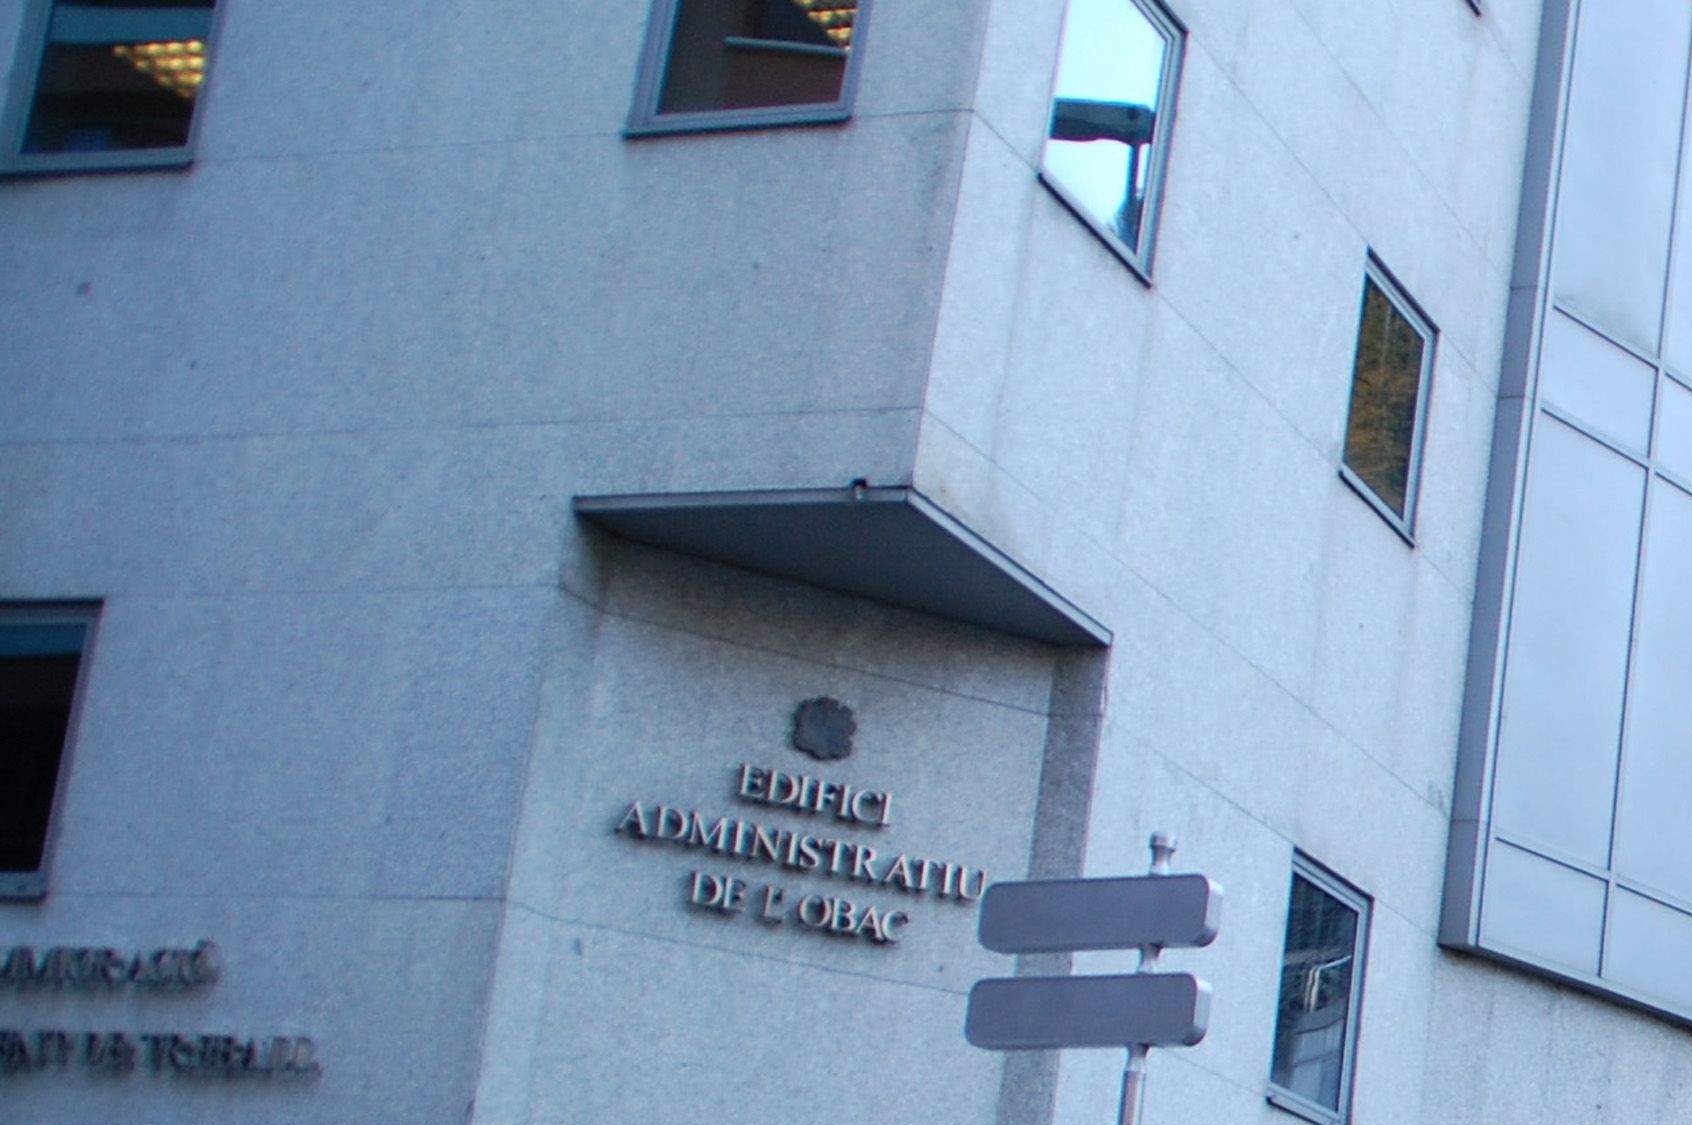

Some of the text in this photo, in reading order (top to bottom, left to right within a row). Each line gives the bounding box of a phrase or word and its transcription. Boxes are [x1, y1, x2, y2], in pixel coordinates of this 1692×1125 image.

[739, 763, 893, 826] EDIFICI
[617, 799, 988, 900] ADMINISTRATIU
[690, 868, 747, 910] DE
